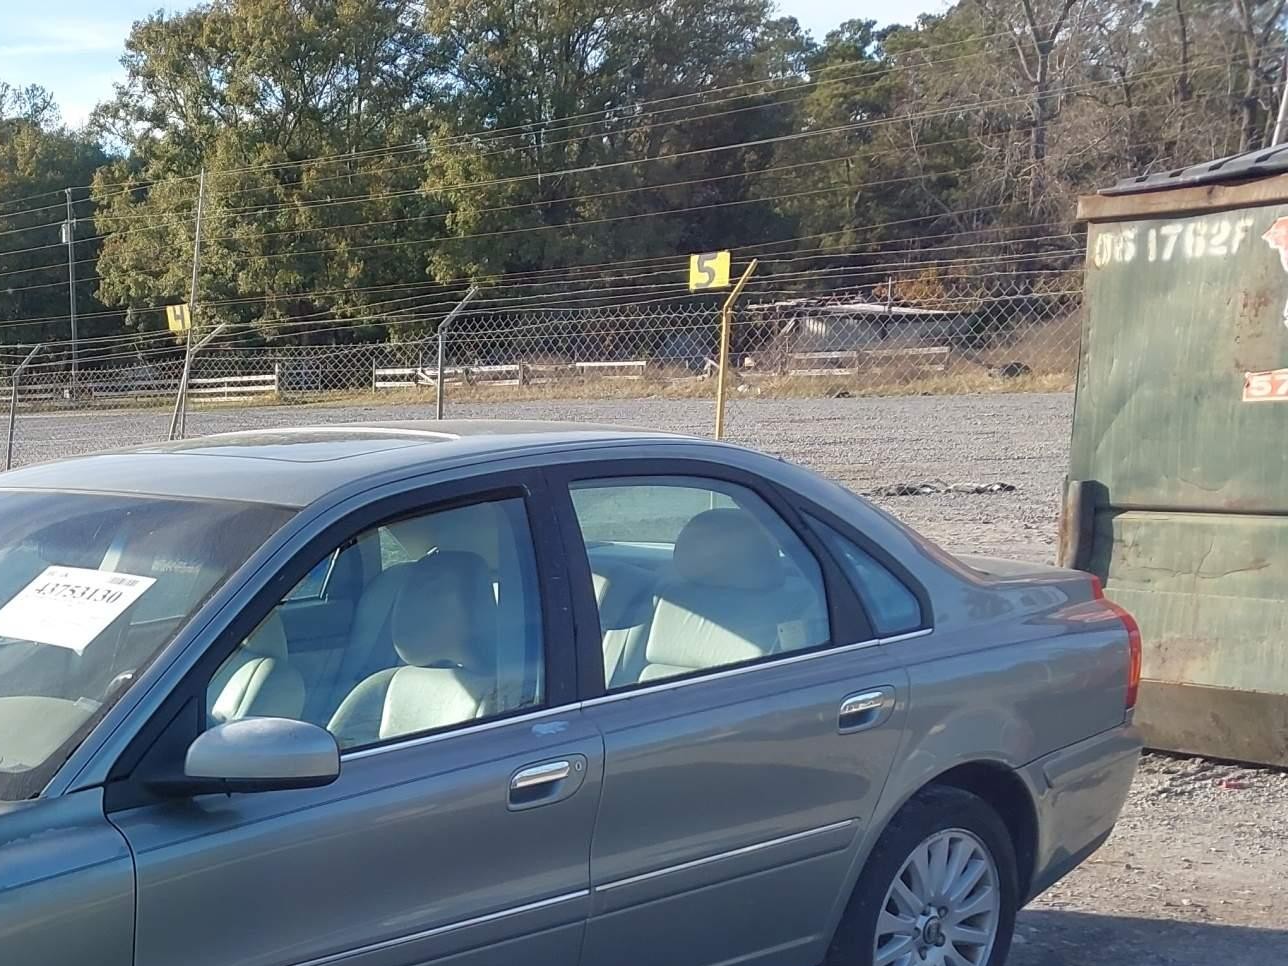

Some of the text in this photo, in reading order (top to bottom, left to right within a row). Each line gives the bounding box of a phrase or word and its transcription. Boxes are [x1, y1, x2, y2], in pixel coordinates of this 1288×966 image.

[697, 252, 718, 288] 5
[173, 305, 186, 329] 4
[35, 582, 123, 604] 43753130
